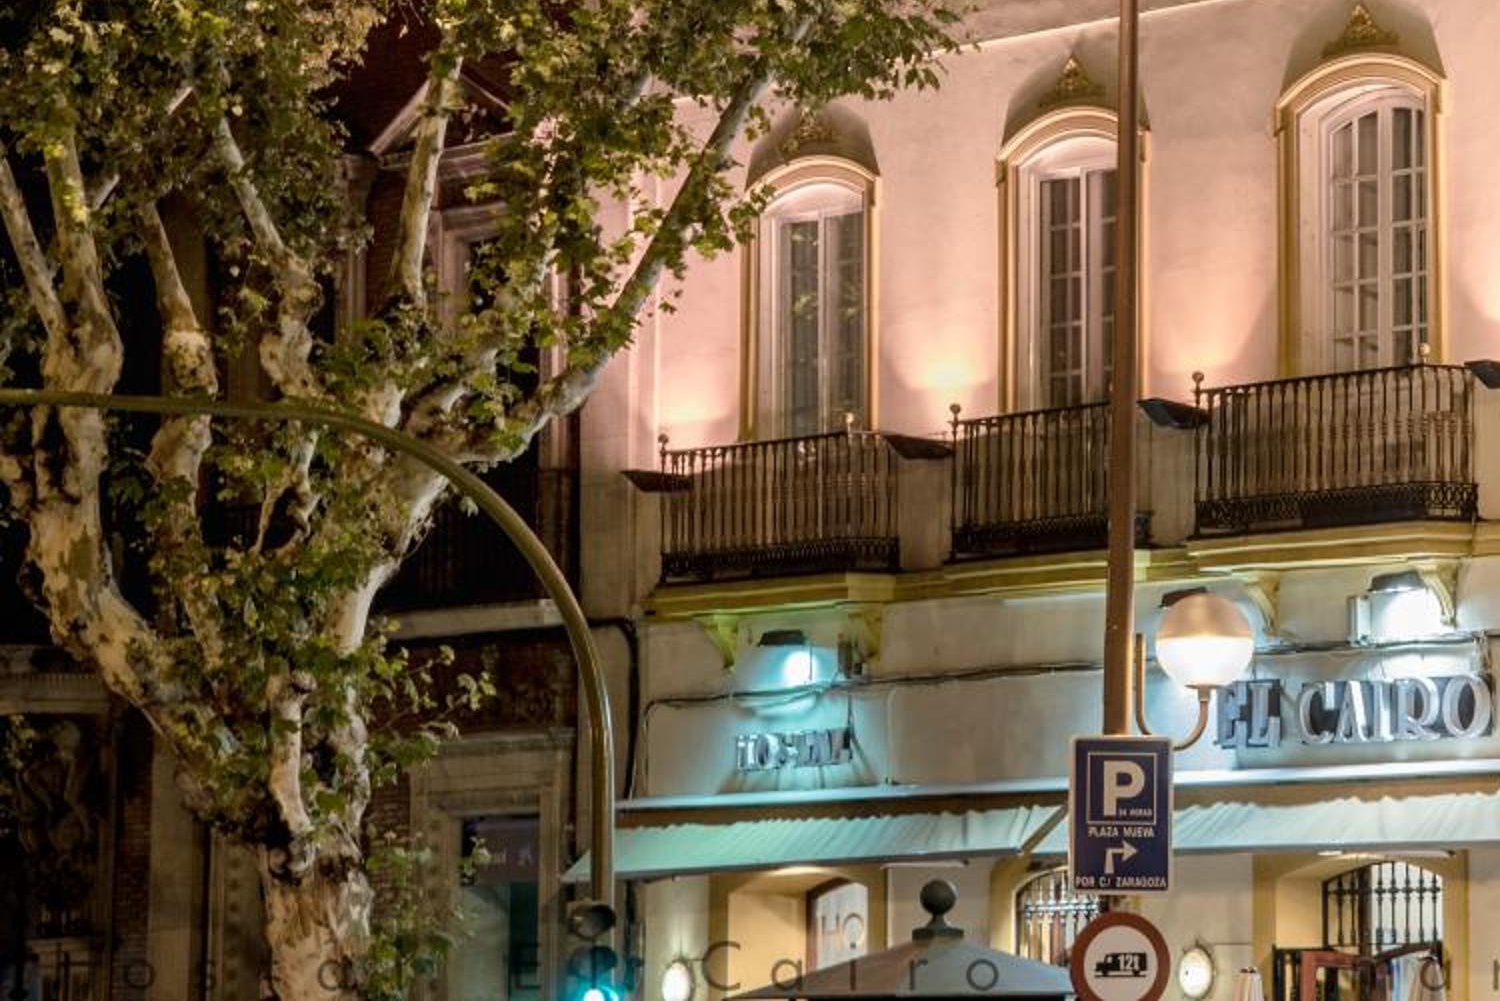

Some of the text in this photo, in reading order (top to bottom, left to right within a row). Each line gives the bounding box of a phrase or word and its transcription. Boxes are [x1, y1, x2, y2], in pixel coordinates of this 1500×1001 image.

[1213, 673, 1495, 747] EL CAIRO
[1103, 759, 1145, 816] P
[1088, 826, 1155, 838] PLAZA NUEVA
[1075, 876, 1095, 888] POR
[1116, 876, 1167, 888] ZARAGOZA
